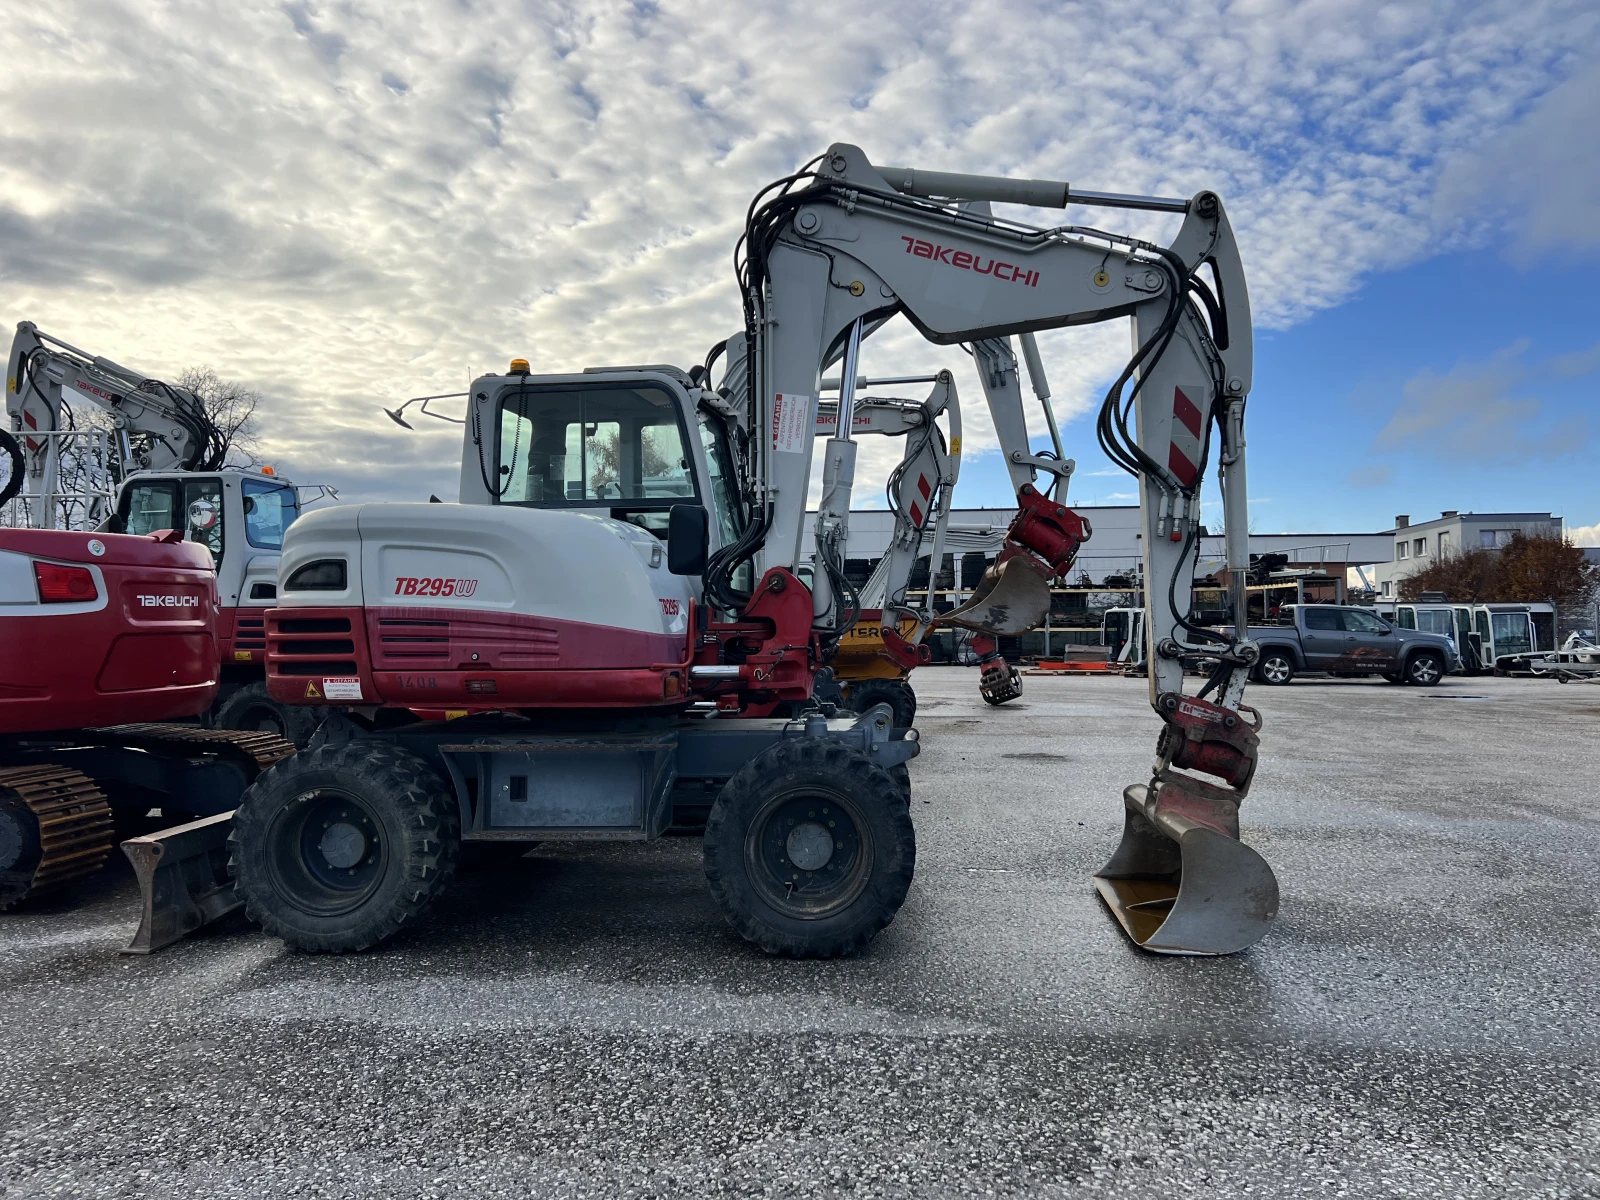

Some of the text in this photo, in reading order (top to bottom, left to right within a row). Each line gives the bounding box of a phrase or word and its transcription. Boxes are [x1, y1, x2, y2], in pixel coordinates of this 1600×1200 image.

[901, 235, 1040, 288] TAKEUCHI
[773, 400, 782, 435] GEFAHR
[779, 409, 788, 444] AUFENTHALT
[136, 595, 199, 607] TAKEUCHI
[394, 577, 479, 598] TB295W
[397, 675, 438, 689] 1408
